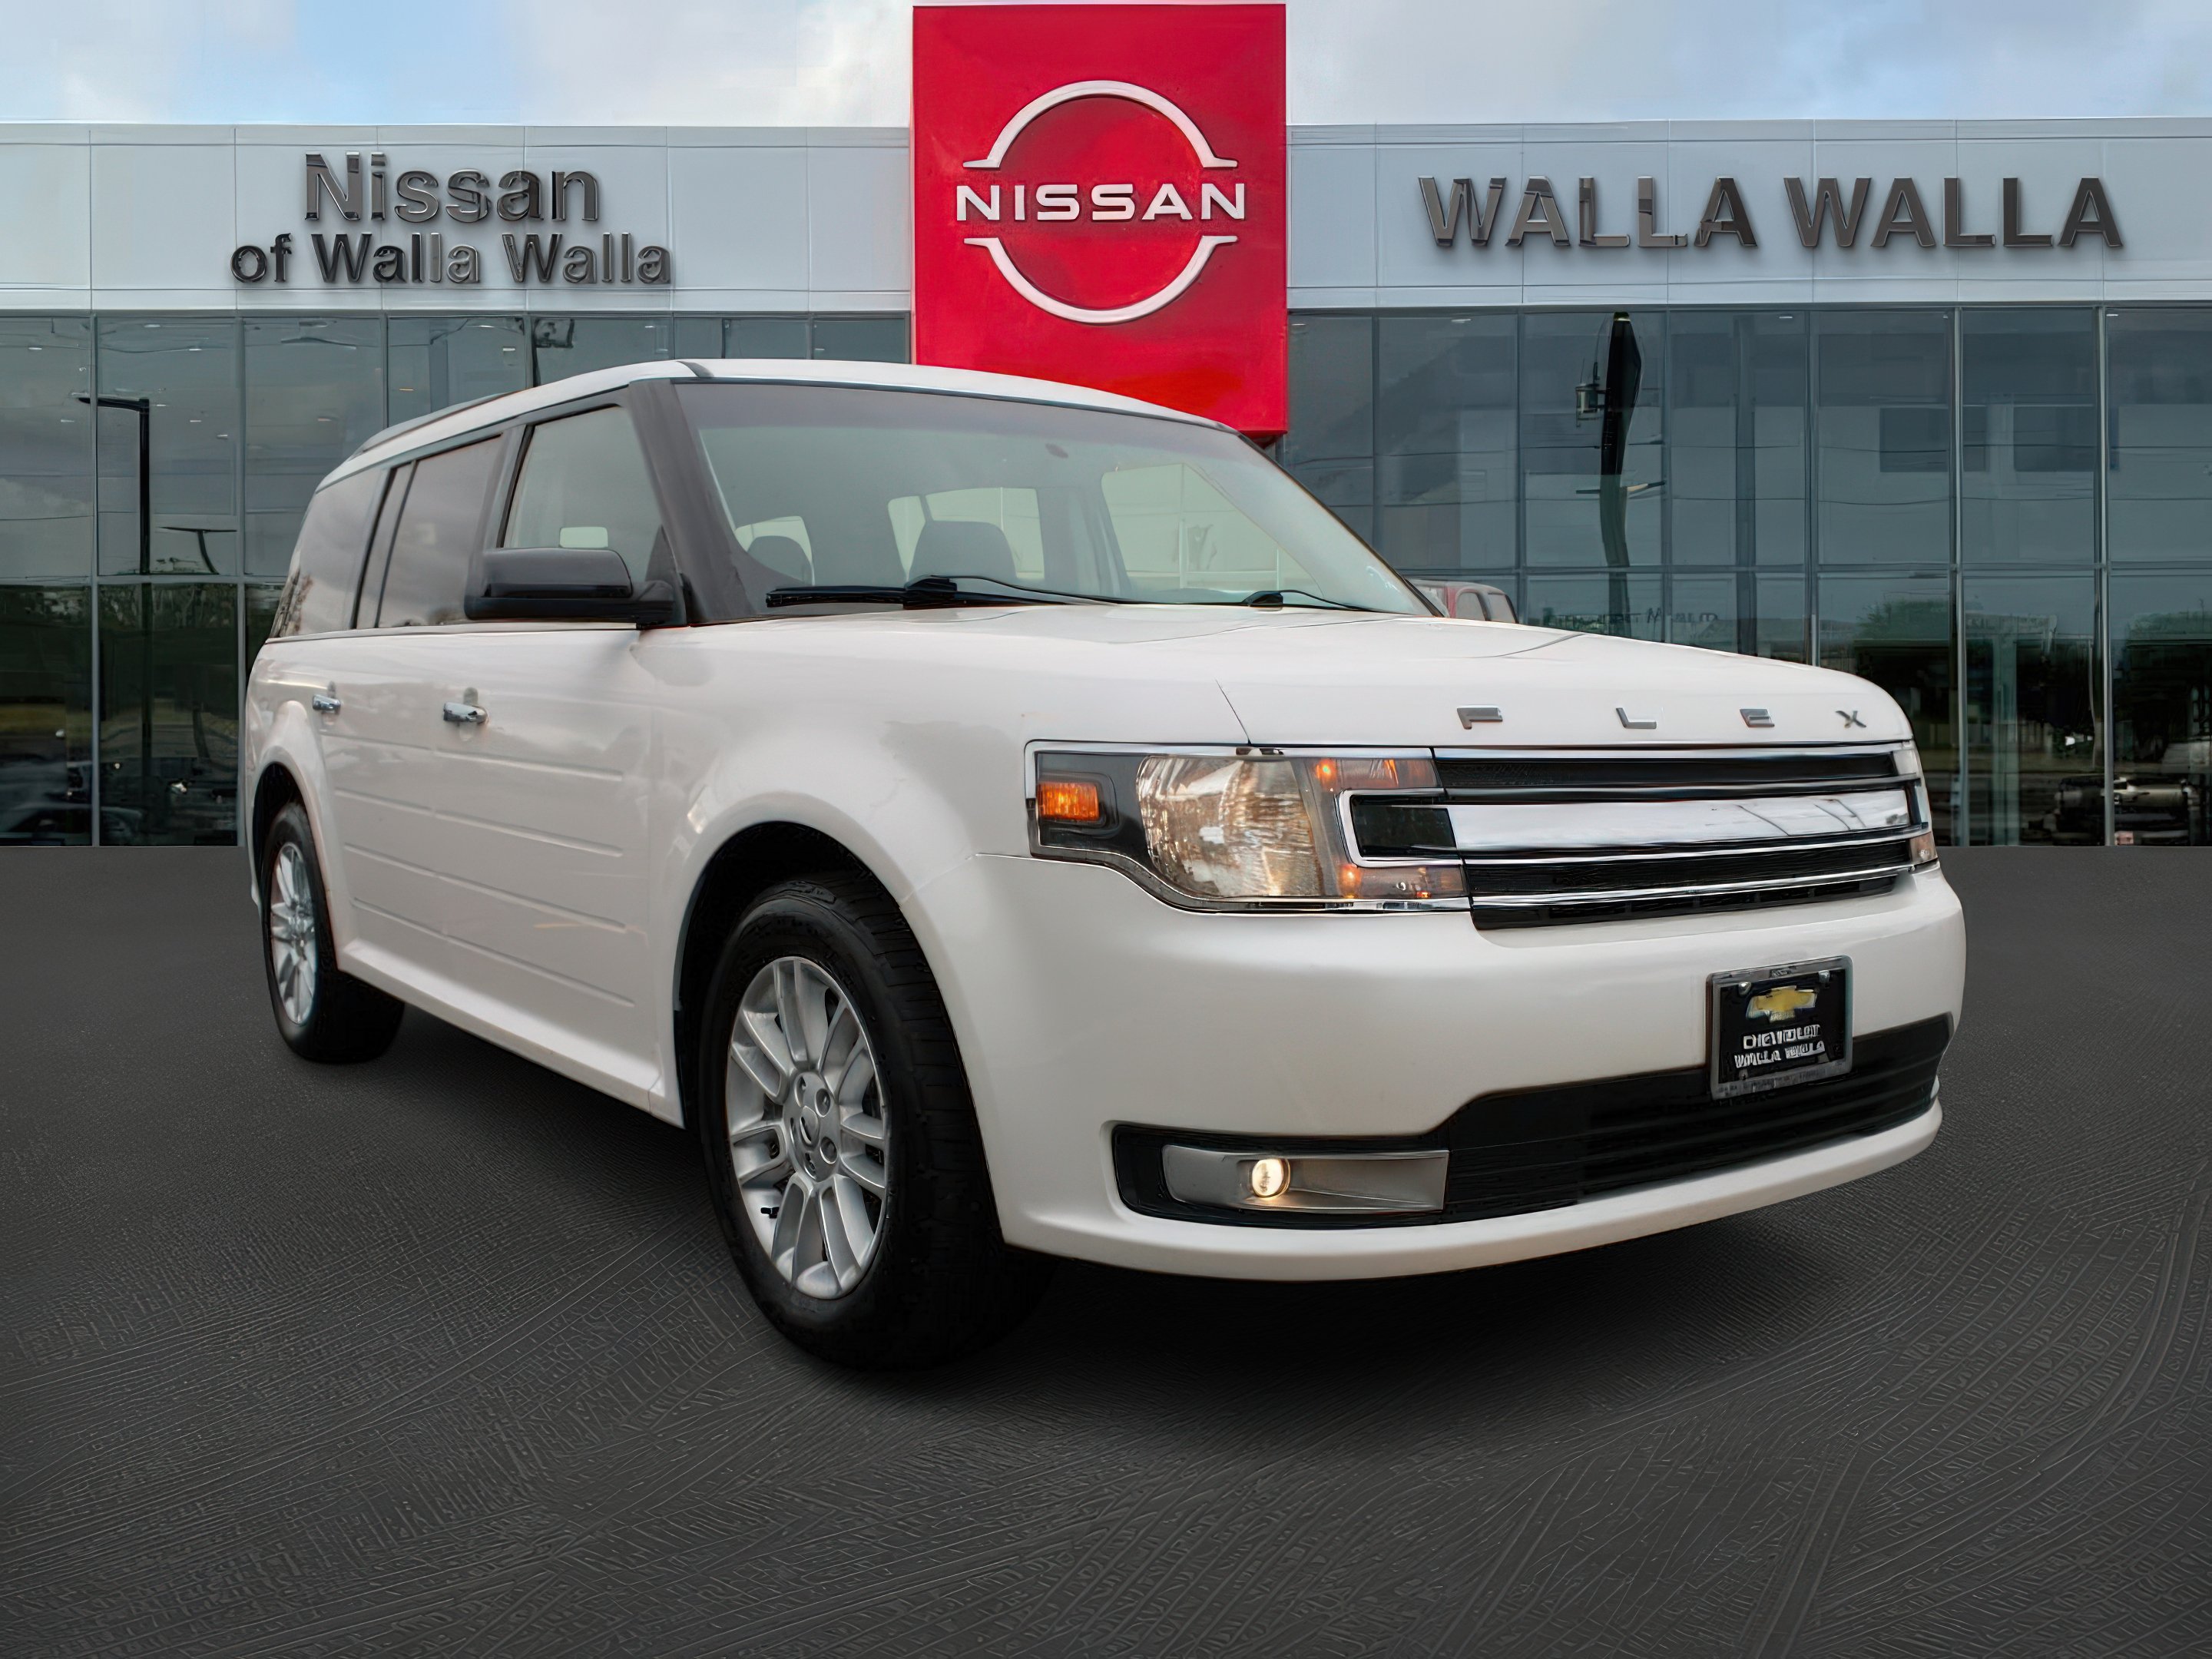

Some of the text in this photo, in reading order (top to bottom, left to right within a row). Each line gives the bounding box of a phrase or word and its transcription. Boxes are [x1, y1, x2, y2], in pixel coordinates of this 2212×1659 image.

[304, 151, 601, 222] Nissan
[956, 183, 1245, 221] NISSAN
[1417, 175, 2124, 248] WALLA WALLA
[230, 233, 672, 284] of Walla Walla
[1456, 704, 1866, 730] FLEX
